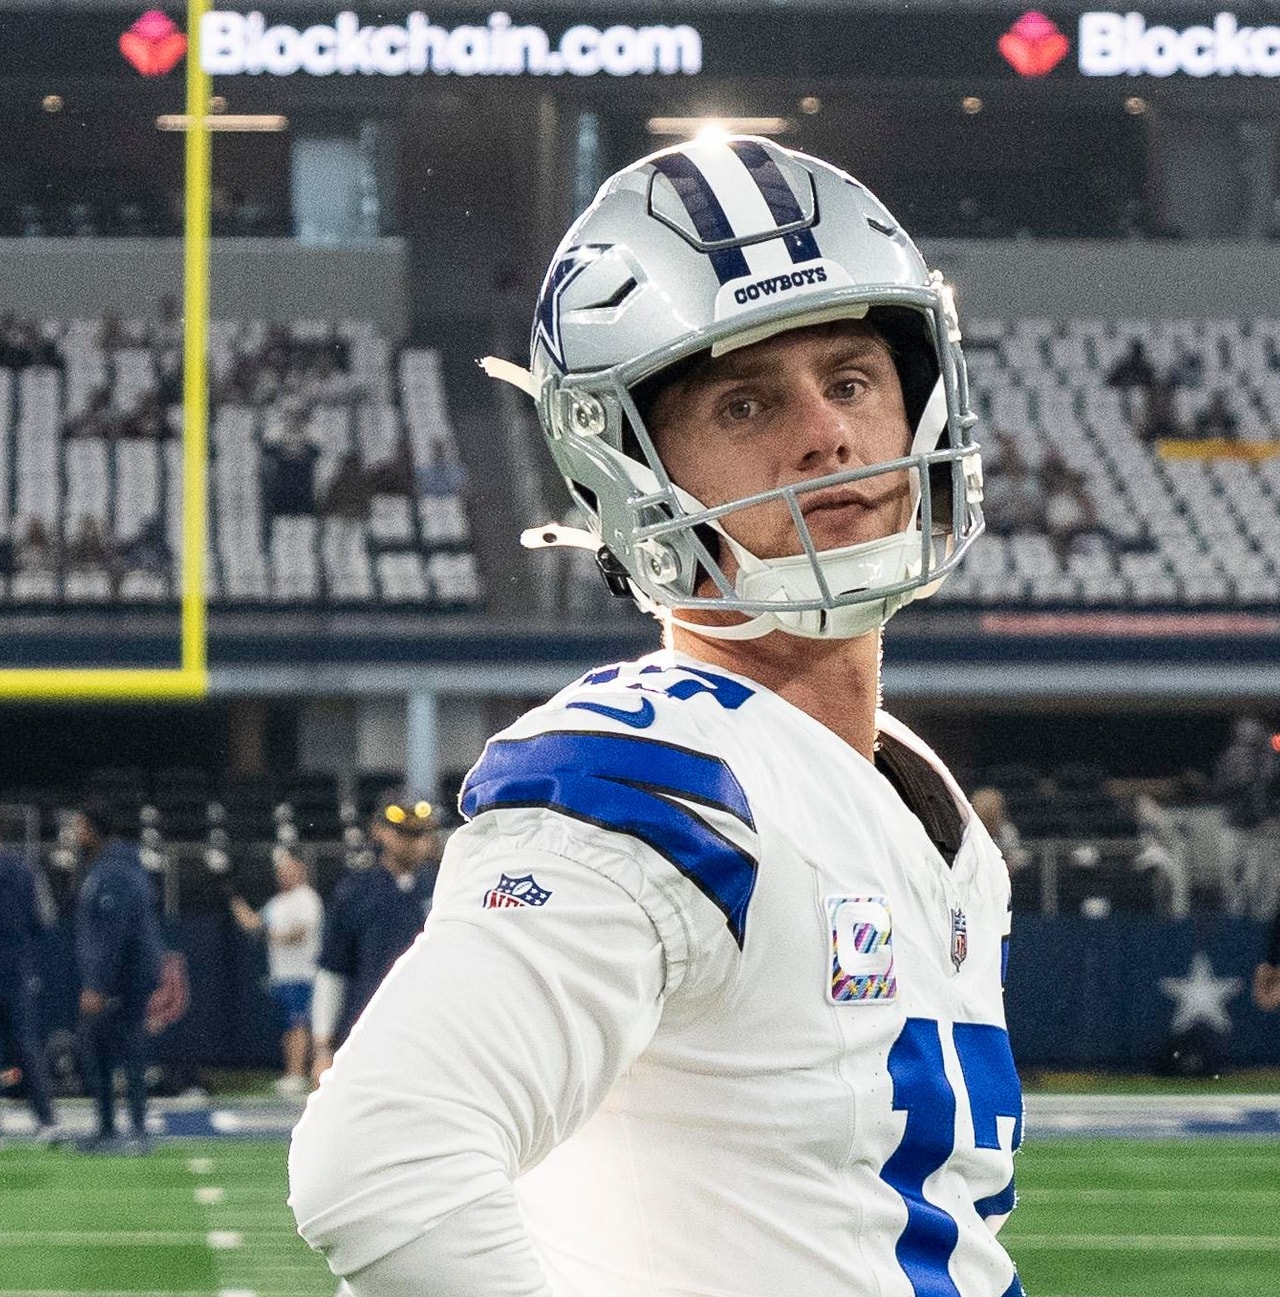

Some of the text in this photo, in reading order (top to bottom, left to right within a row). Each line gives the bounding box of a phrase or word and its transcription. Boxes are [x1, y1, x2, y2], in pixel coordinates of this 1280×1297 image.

[197, 10, 702, 76] Blockchain.com
[734, 266, 828, 305] COWBOYS
[836, 902, 891, 976] C
